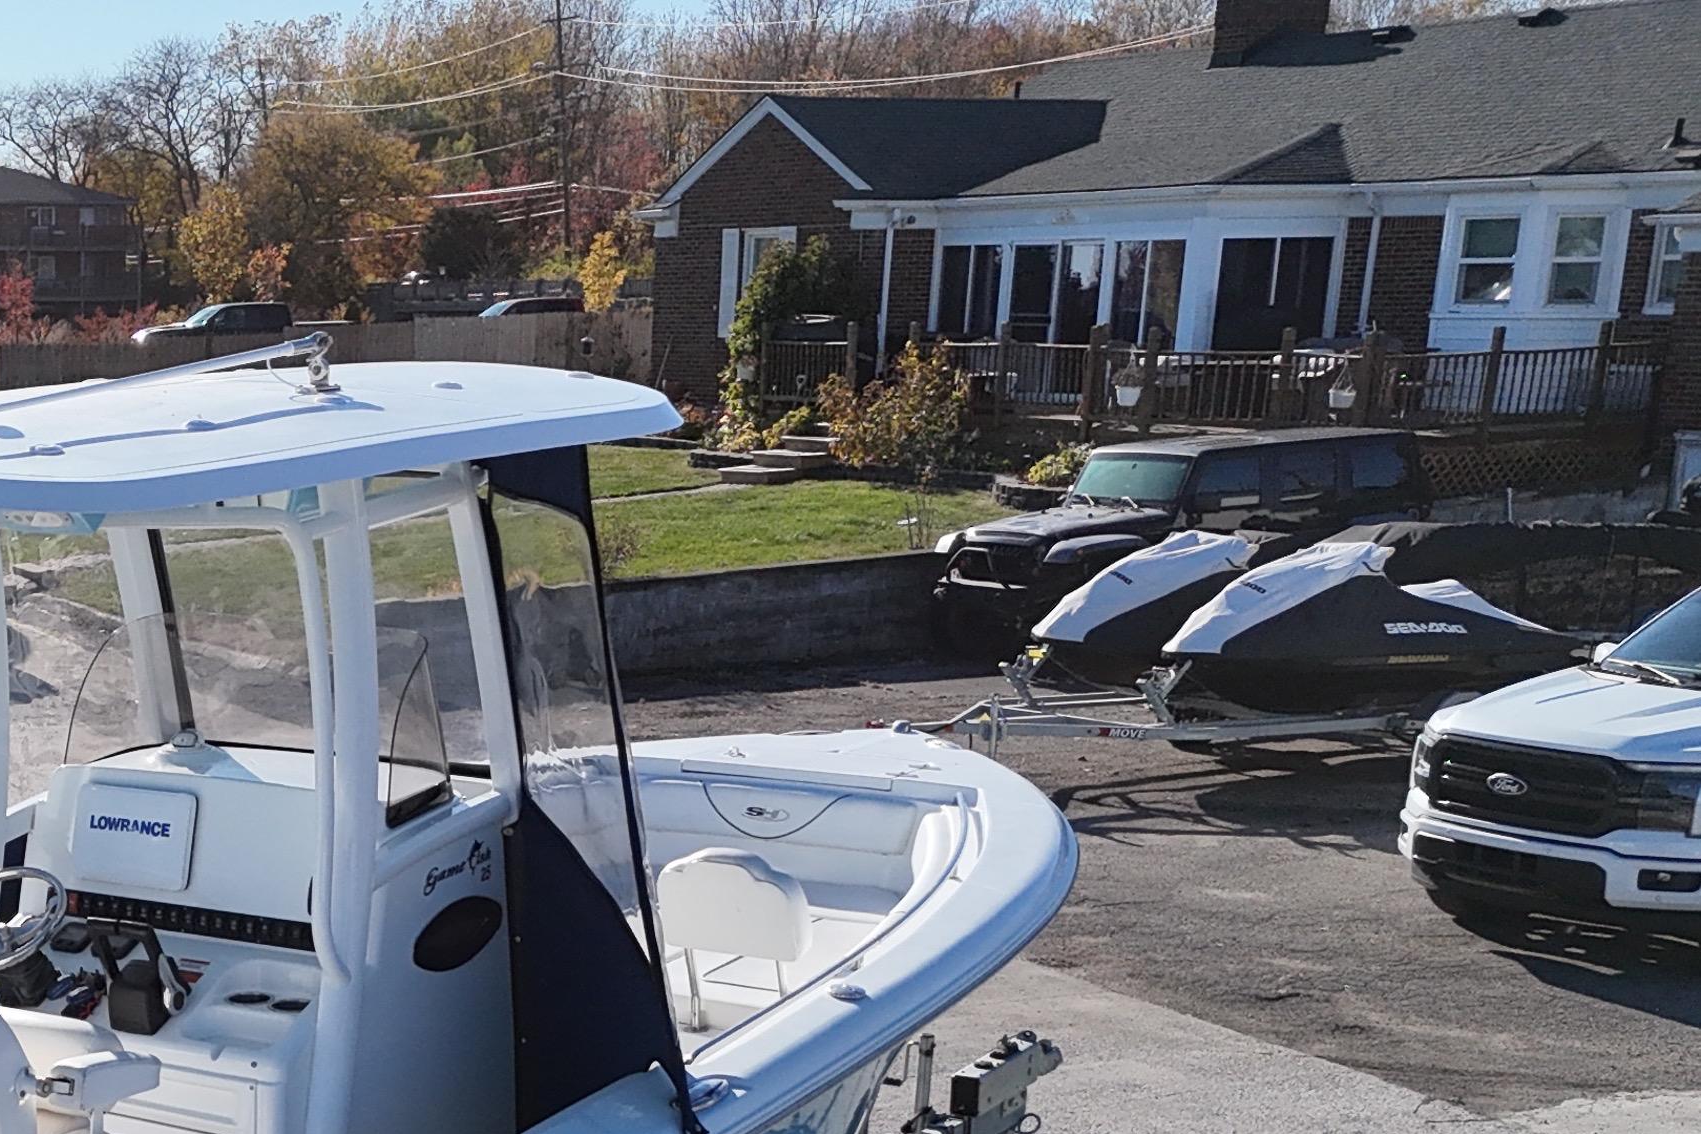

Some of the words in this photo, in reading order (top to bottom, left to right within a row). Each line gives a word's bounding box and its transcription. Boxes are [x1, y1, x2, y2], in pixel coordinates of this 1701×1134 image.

[1109, 728, 1147, 738] MOVE
[1492, 777, 1521, 793] Ford
[90, 814, 171, 838] LOWRANCE
